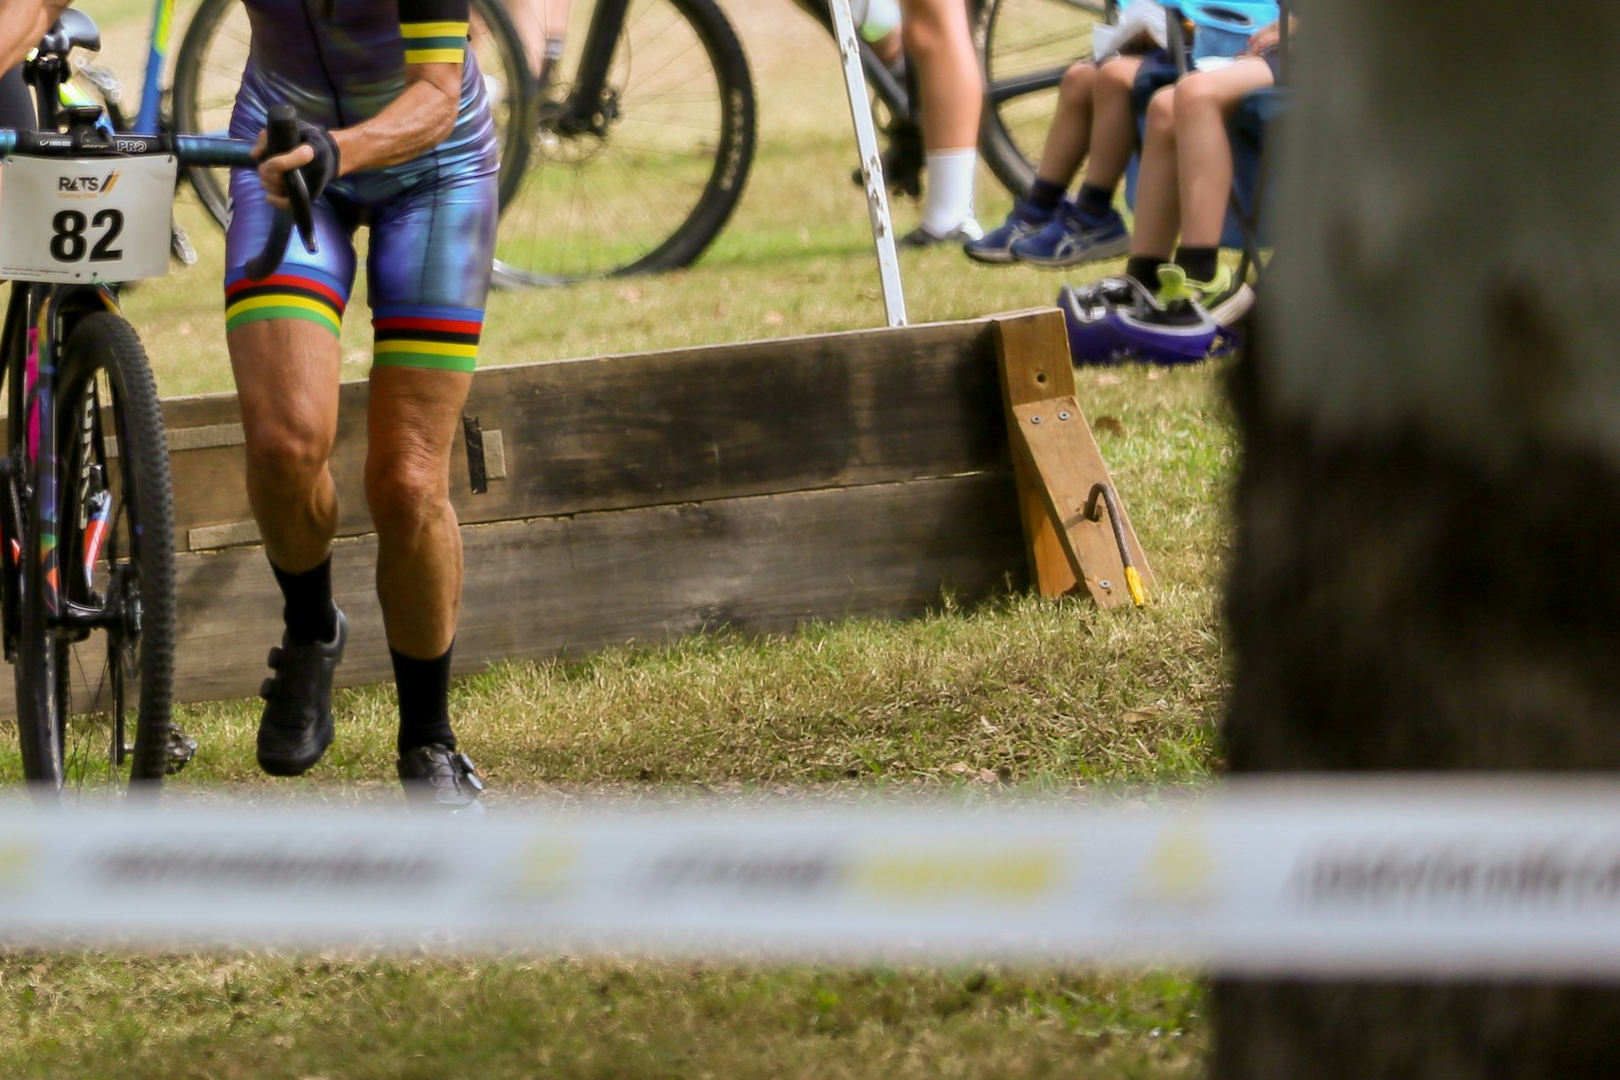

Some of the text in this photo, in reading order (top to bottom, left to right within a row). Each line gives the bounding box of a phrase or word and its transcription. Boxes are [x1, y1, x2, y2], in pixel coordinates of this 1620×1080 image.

[116, 139, 148, 153] PRO
[58, 176, 99, 192] RATS
[50, 209, 125, 263] 82
